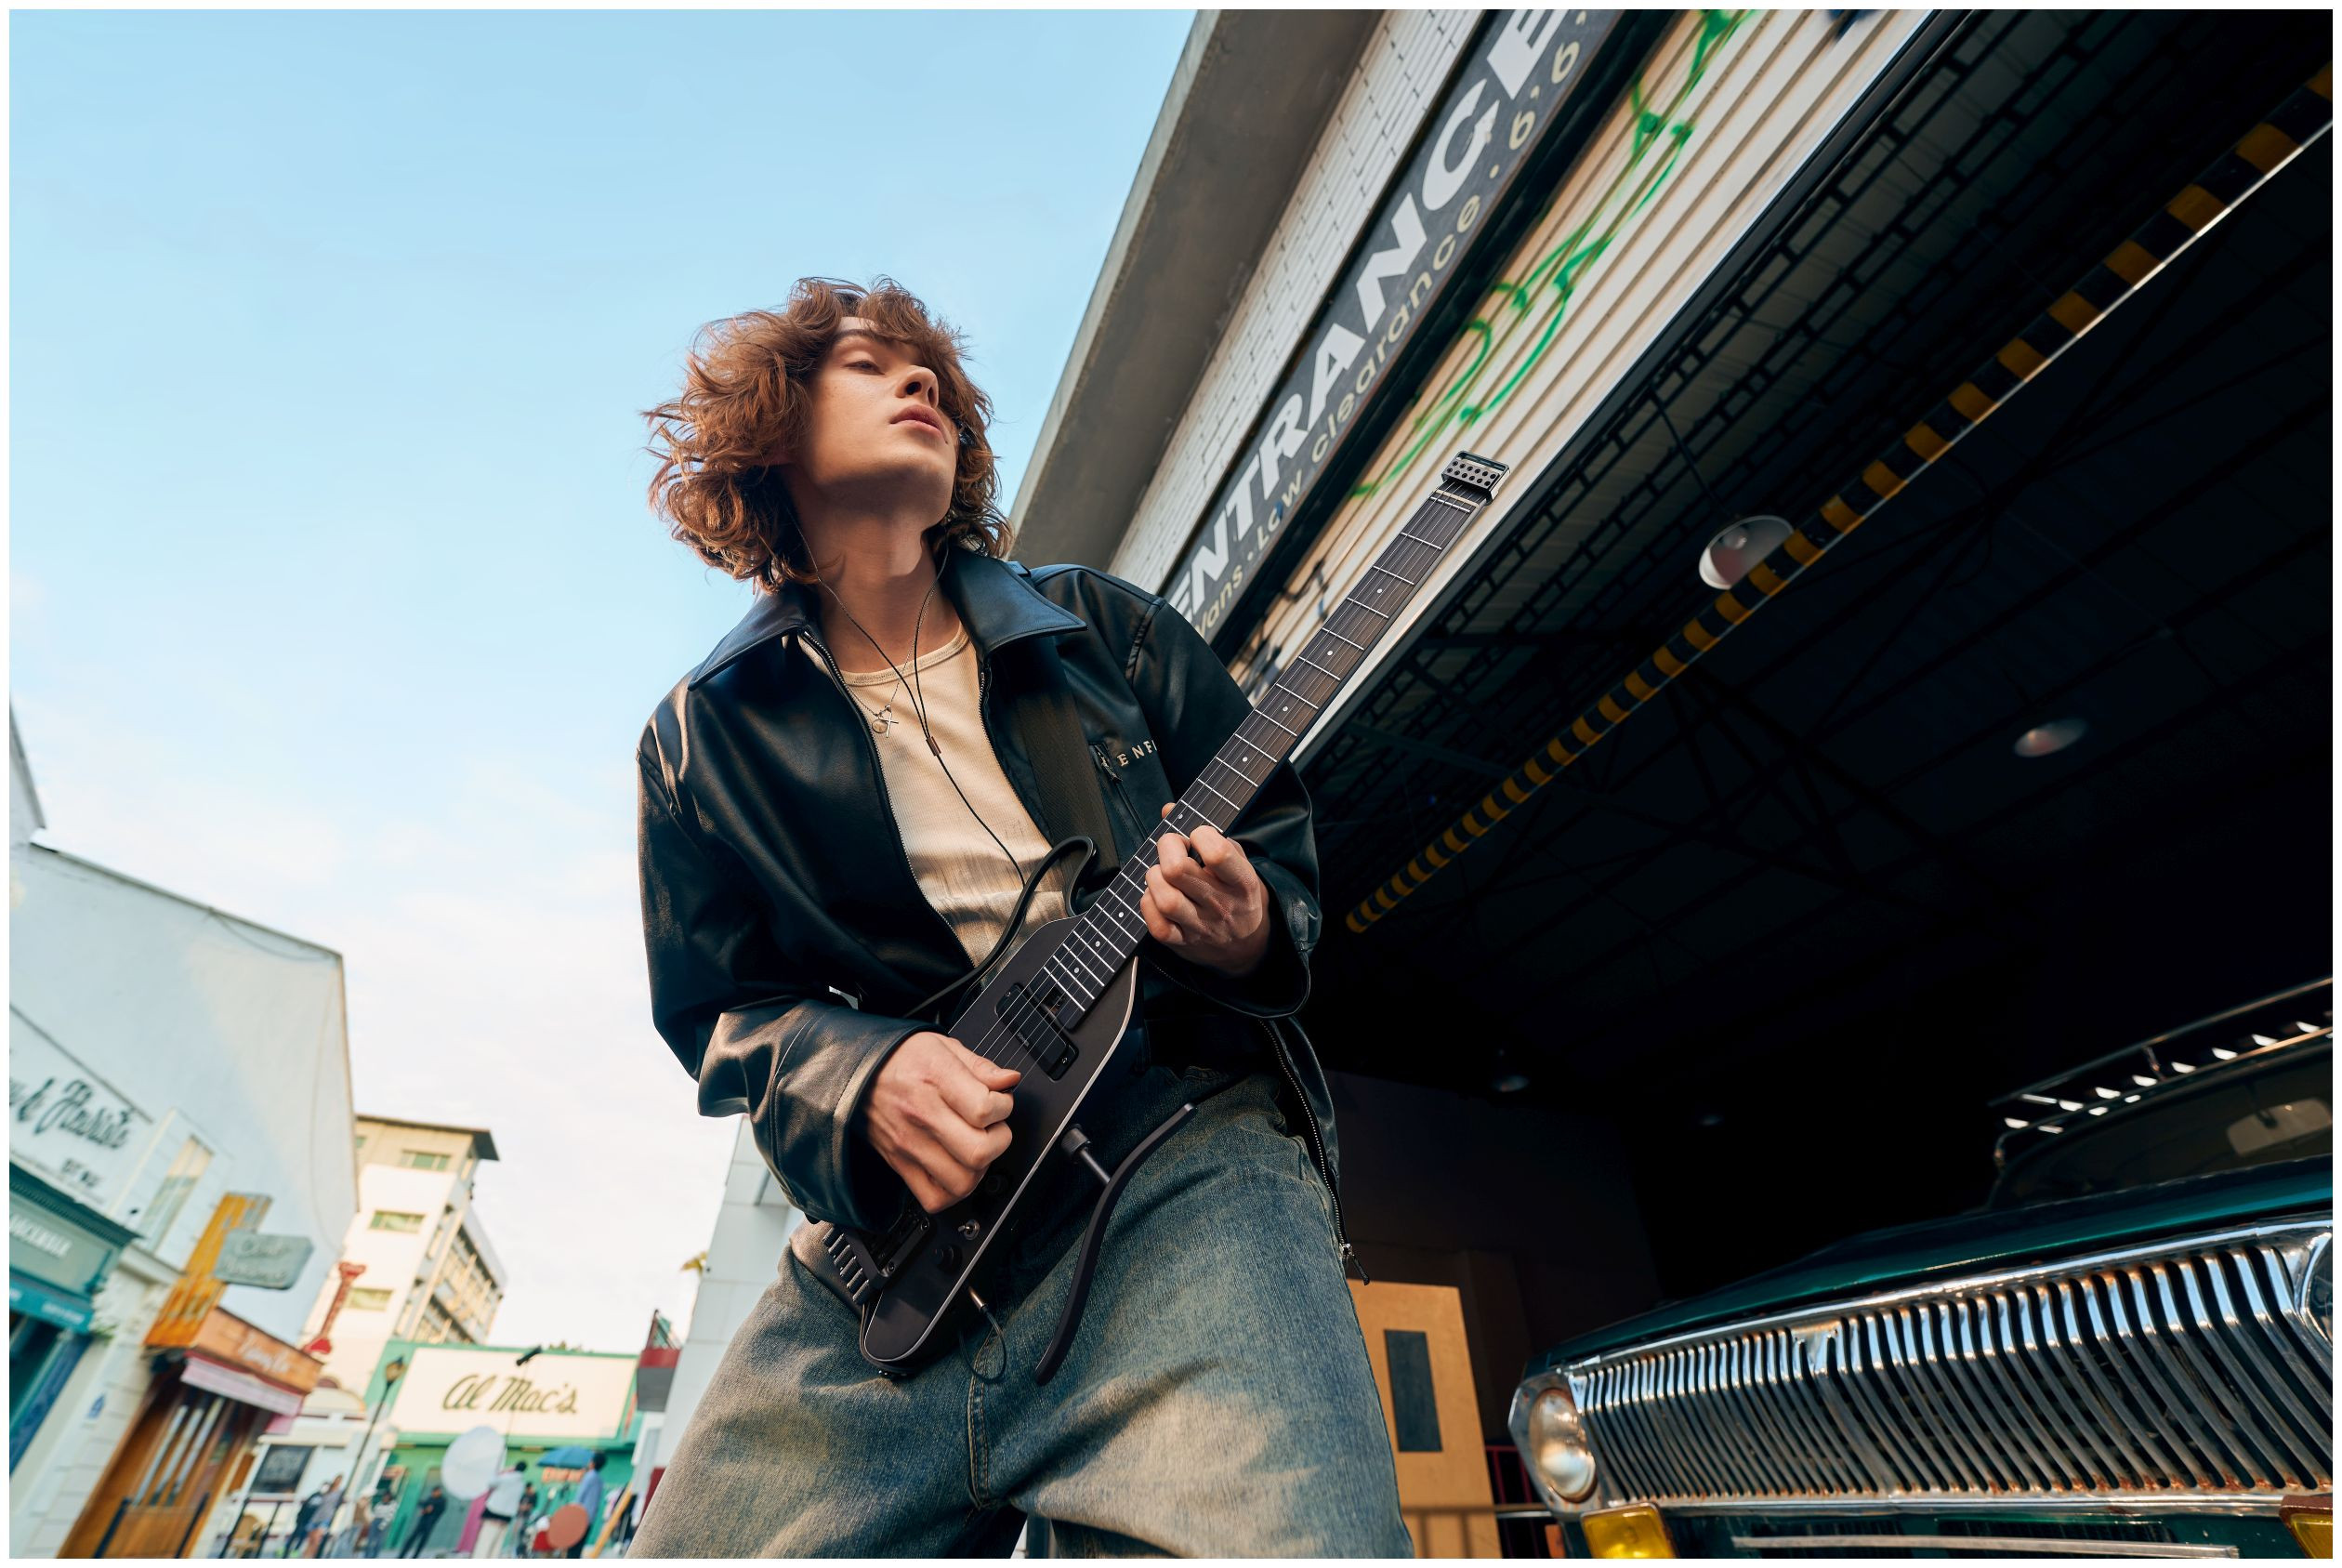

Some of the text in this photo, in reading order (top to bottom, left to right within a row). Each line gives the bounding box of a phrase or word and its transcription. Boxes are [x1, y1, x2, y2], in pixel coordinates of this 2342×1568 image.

[1311, 193, 1480, 463] clearance
[442, 1374, 577, 1414] Al Mac's
